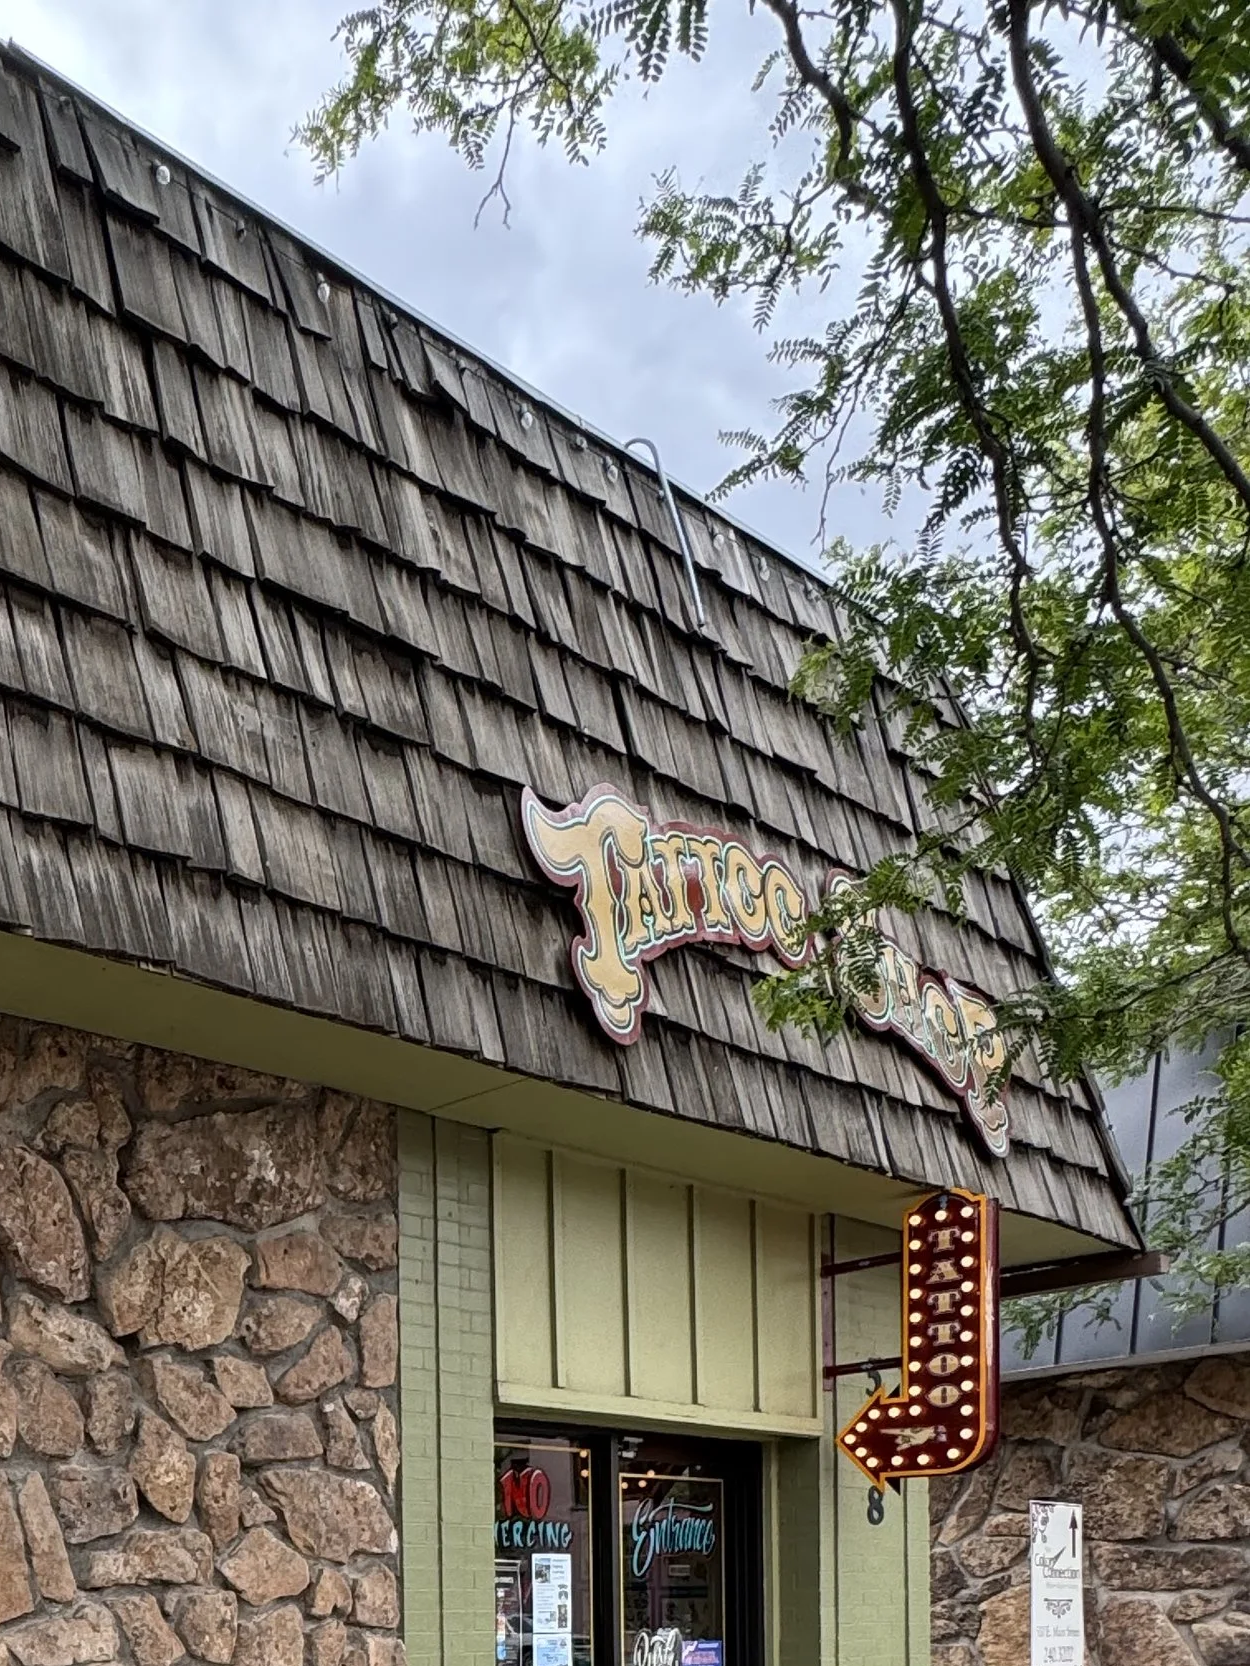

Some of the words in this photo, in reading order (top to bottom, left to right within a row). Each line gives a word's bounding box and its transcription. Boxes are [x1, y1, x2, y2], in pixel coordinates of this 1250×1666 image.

[925, 1225, 963, 1408] TATTOO
[499, 1466, 550, 1520] NO
[494, 1519, 573, 1549] IERCING
[631, 1496, 716, 1577] Entrance
